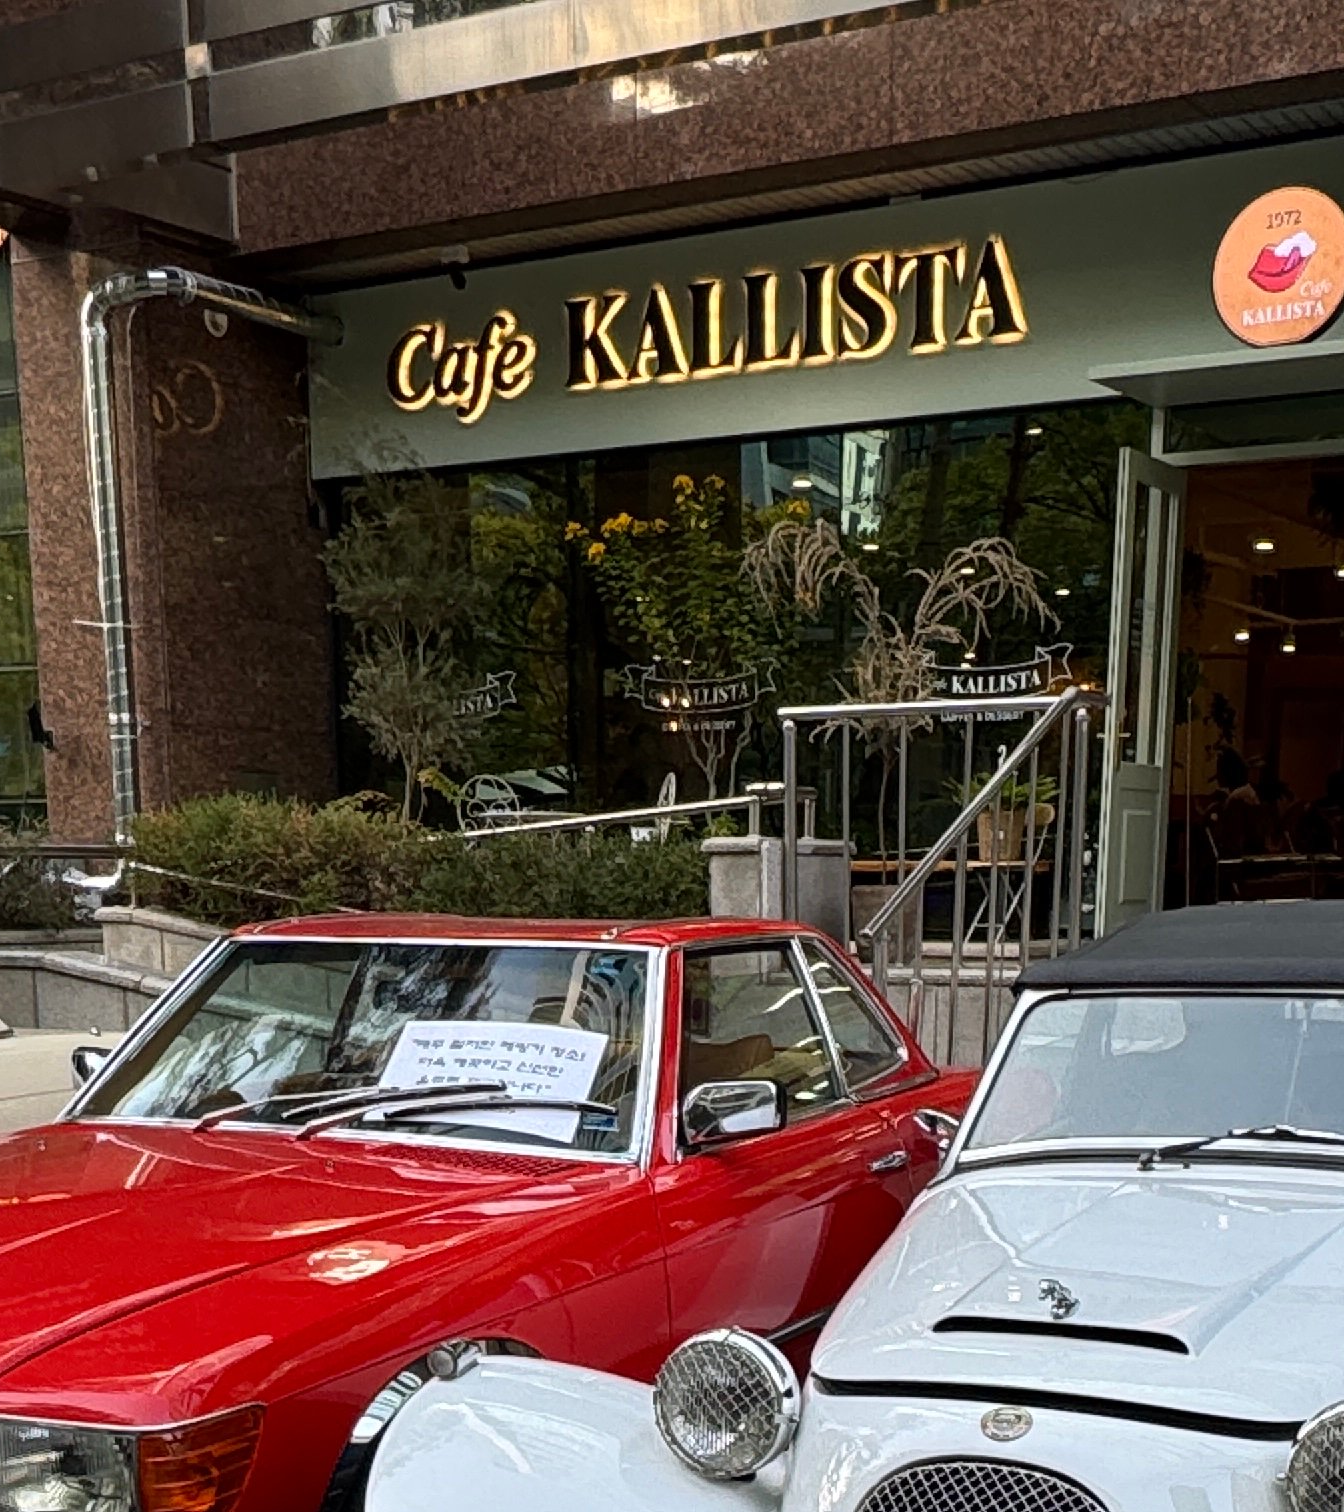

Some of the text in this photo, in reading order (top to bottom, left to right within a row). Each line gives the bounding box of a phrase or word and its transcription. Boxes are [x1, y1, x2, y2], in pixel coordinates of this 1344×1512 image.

[1241, 299, 1326, 327] KALLISTA
[387, 231, 1030, 425] Cafe KALLISTA
[951, 668, 1042, 694] KALLISTA
